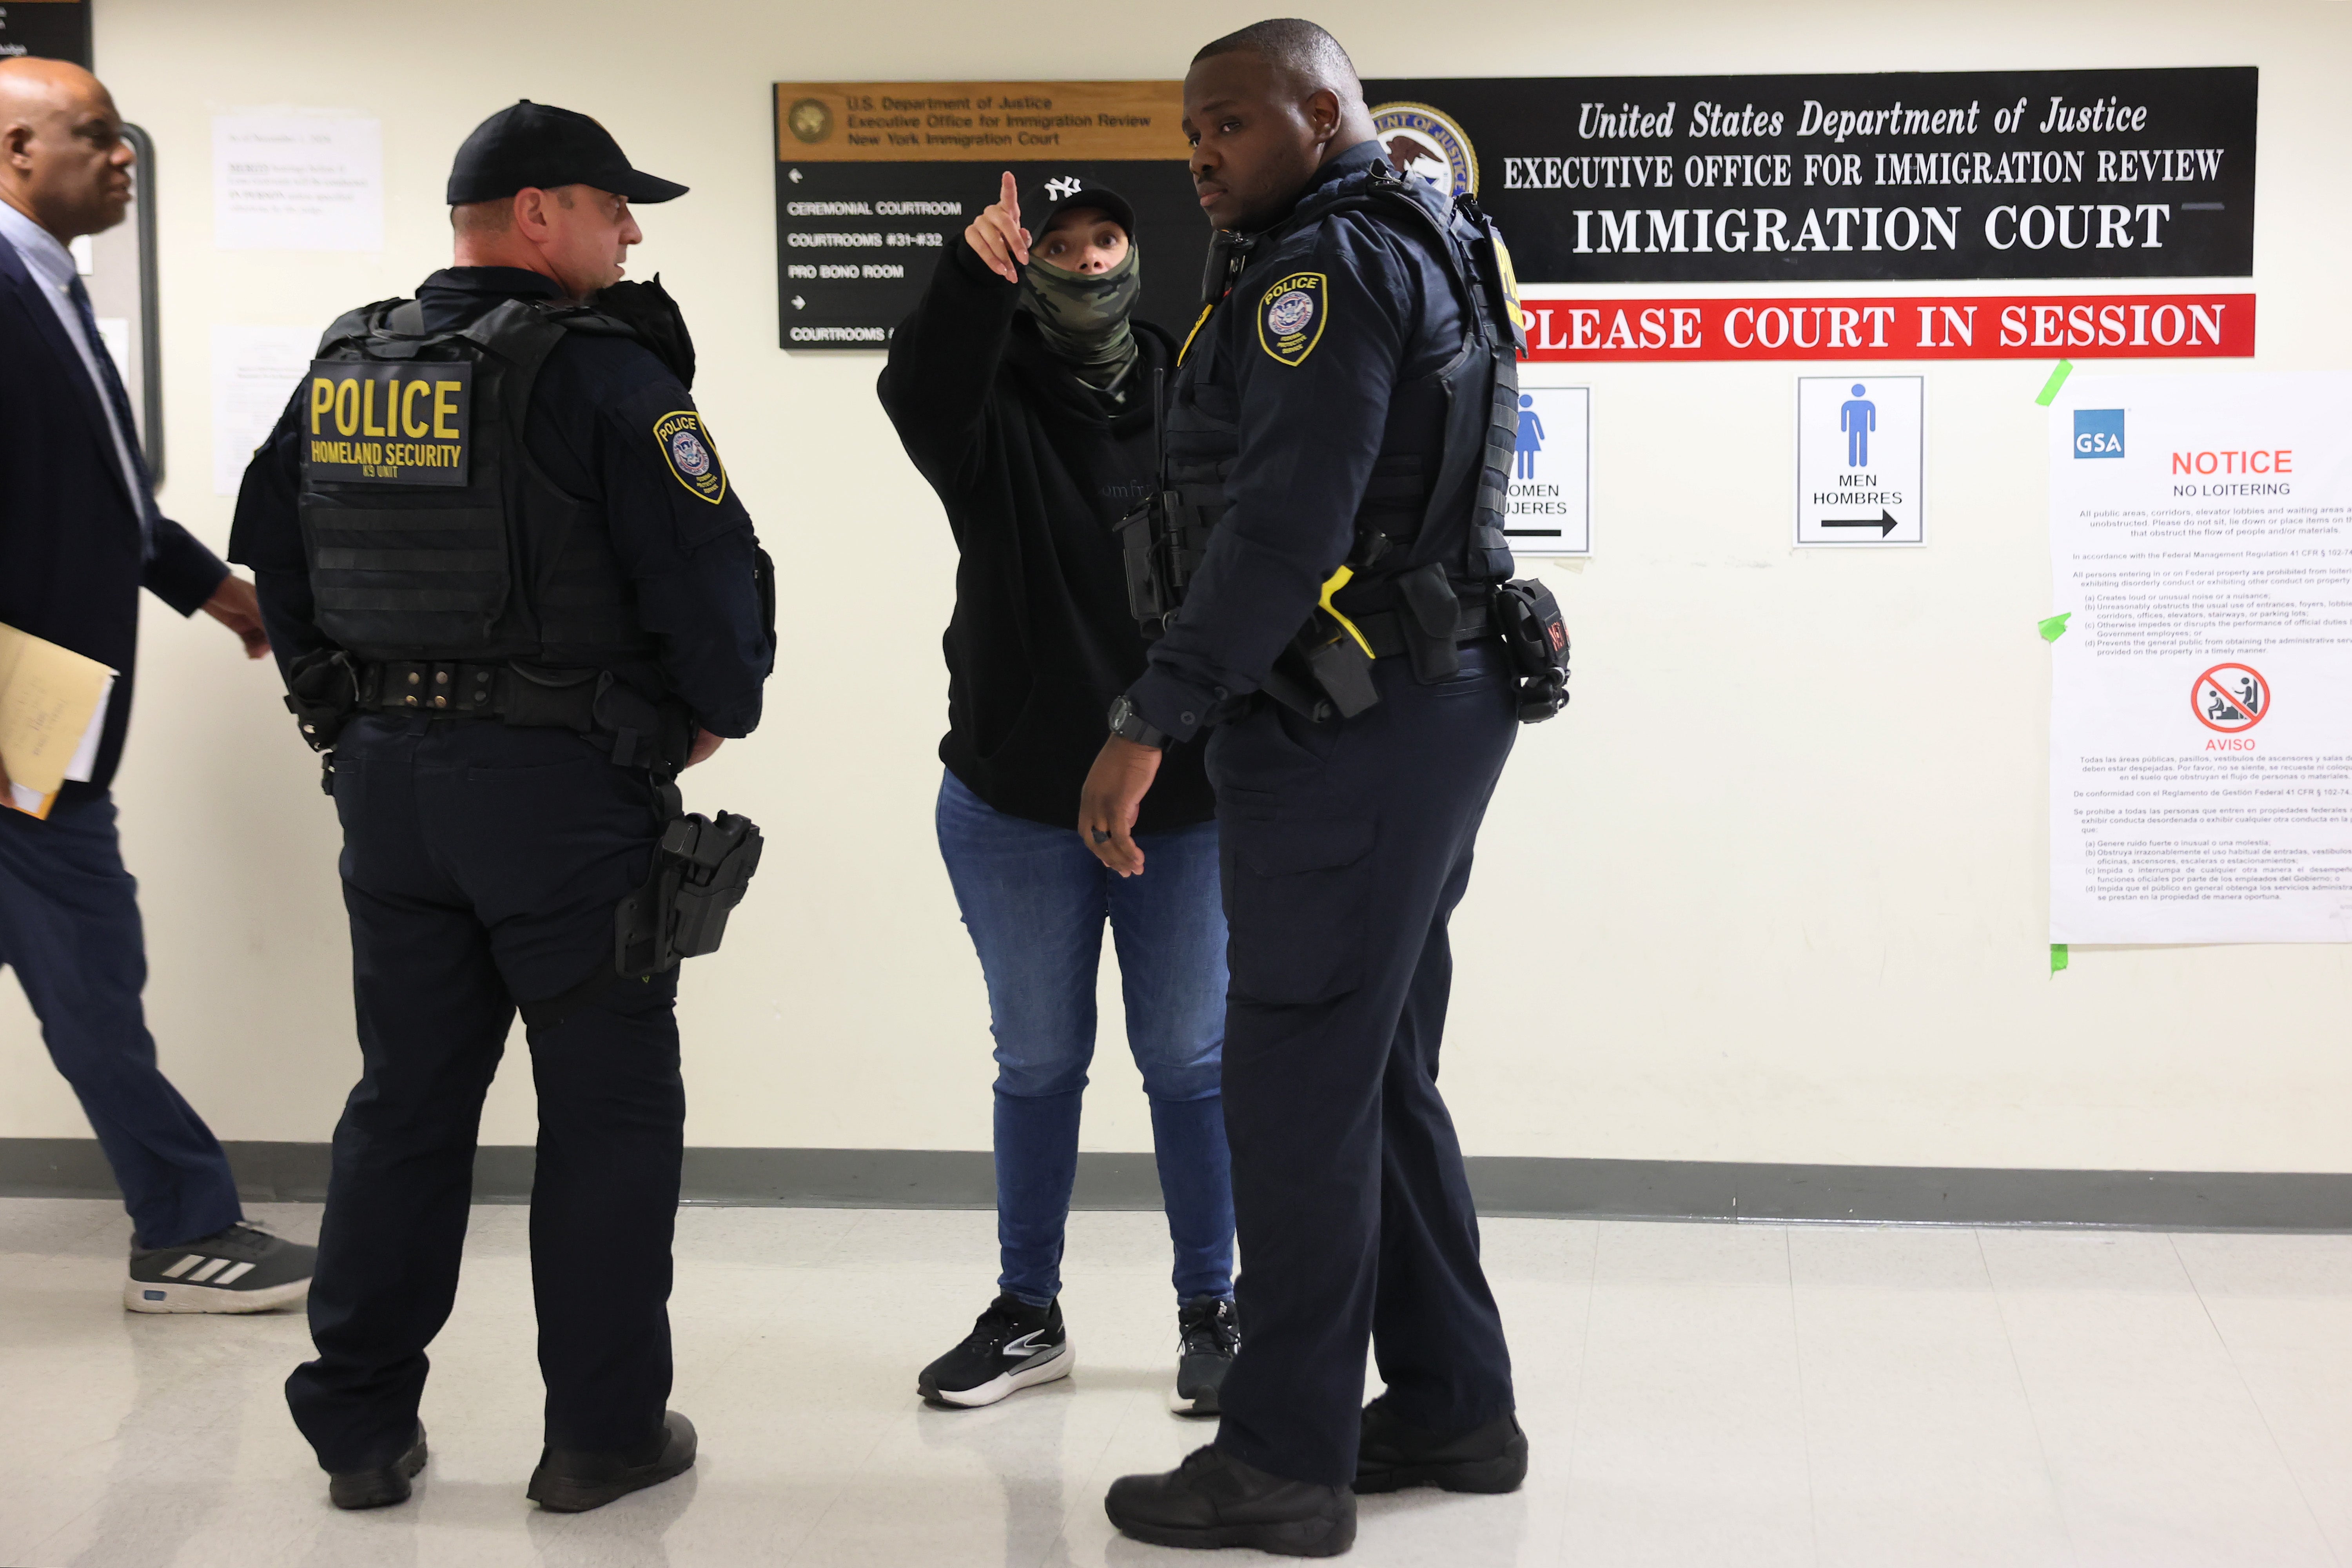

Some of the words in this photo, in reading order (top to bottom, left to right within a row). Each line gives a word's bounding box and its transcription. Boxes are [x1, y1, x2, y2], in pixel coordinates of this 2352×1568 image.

[882, 96, 971, 111] Department
[976, 96, 993, 109] of
[999, 96, 1053, 110] Justice
[846, 114, 920, 128] Executive
[926, 114, 973, 128] Office
[978, 113, 1000, 127] for
[1006, 113, 1093, 131] Immigration
[1098, 113, 1152, 127] Review
[1578, 101, 1676, 139] United
[1688, 101, 1784, 138] States
[1796, 100, 1980, 143] Department
[1994, 96, 2027, 134] of
[2039, 95, 2147, 134] Justice
[848, 132, 881, 145] New
[887, 132, 920, 146] York
[926, 133, 1013, 149] Immigration
[1017, 131, 1060, 145] Court
[1434, 130, 1467, 192] JUSTICE
[1503, 155, 1673, 189] EXECUTIVE
[1684, 154, 1791, 188] OFFICE
[1803, 153, 1863, 186] FOR
[1874, 150, 2085, 185] IMMIGRATION
[2096, 148, 2225, 182] REVIEW
[786, 201, 874, 216] CEREMONIAL
[875, 201, 962, 216] COURTROOM
[1572, 206, 1962, 254] IMMIGRATION
[1984, 203, 2170, 250] COURT
[787, 232, 883, 248] COURTROOMS
[886, 232, 943, 247] #31-#32
[787, 264, 818, 279] PRO
[818, 264, 860, 279] BONO
[862, 264, 904, 279] ROOM
[1264, 277, 1319, 306] POLICE
[789, 327, 886, 341] COURTROOMS
[1724, 307, 1895, 348] COURT
[1916, 306, 1978, 347] IN
[2000, 304, 2226, 347] SESSION
[311, 377, 462, 439] POLICE
[659, 417, 697, 442] POLICE
[2076, 432, 2122, 453] GSA
[312, 441, 383, 465] HOMELAND
[385, 443, 462, 468] SECURITY
[2172, 449, 2293, 475] NOTICE
[377, 465, 399, 477] UNIT
[1839, 474, 1877, 487] MEN
[1508, 485, 1559, 497] OMEN
[1813, 492, 1902, 505] HOMBRES
[2174, 485, 2197, 497] NO
[2203, 483, 2290, 496] LOITERING
[2205, 738, 2256, 752] AVISO
